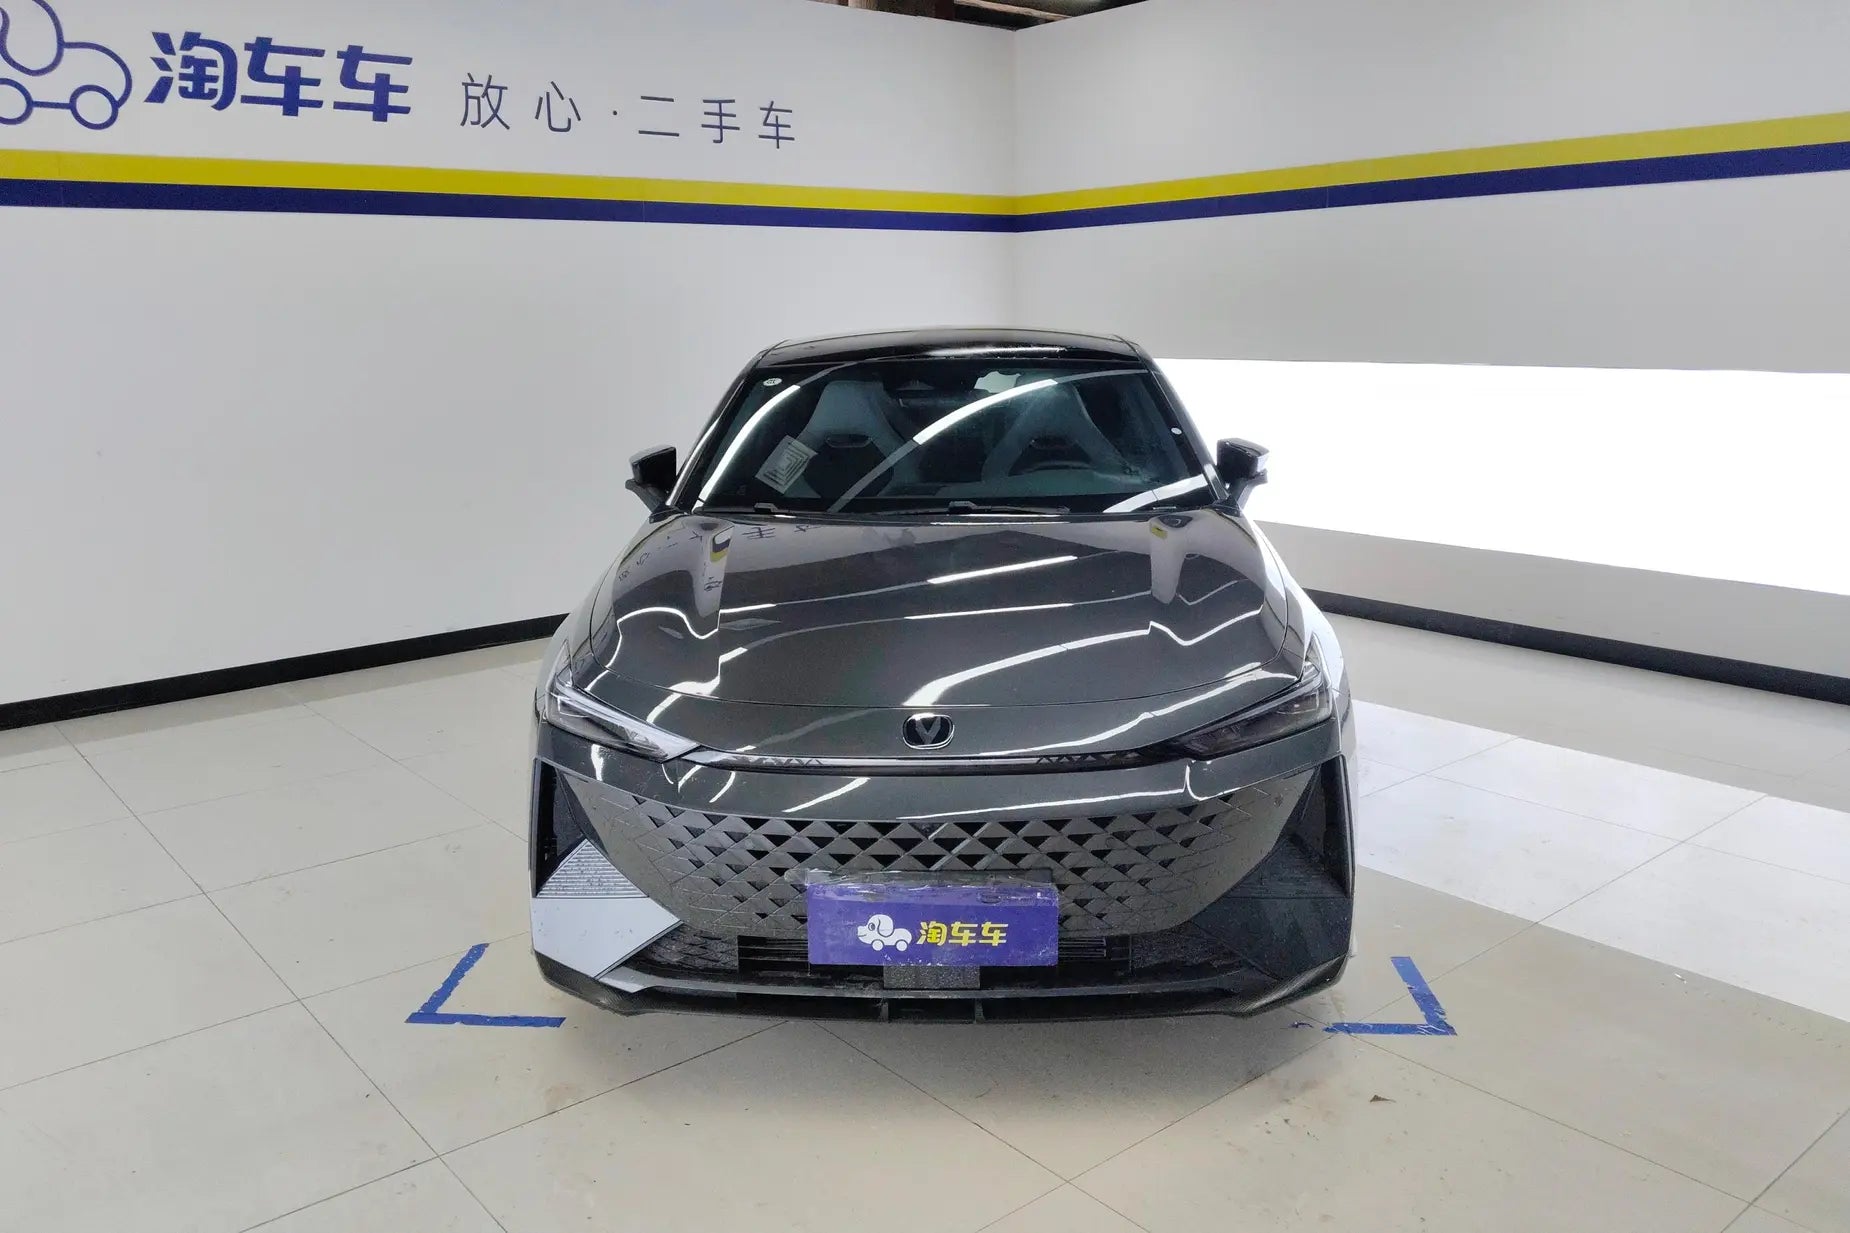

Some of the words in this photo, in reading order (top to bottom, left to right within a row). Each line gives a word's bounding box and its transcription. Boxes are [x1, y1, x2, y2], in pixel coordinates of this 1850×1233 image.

[144, 31, 413, 123] 淘车车
[916, 921, 1009, 947] 淘车车
